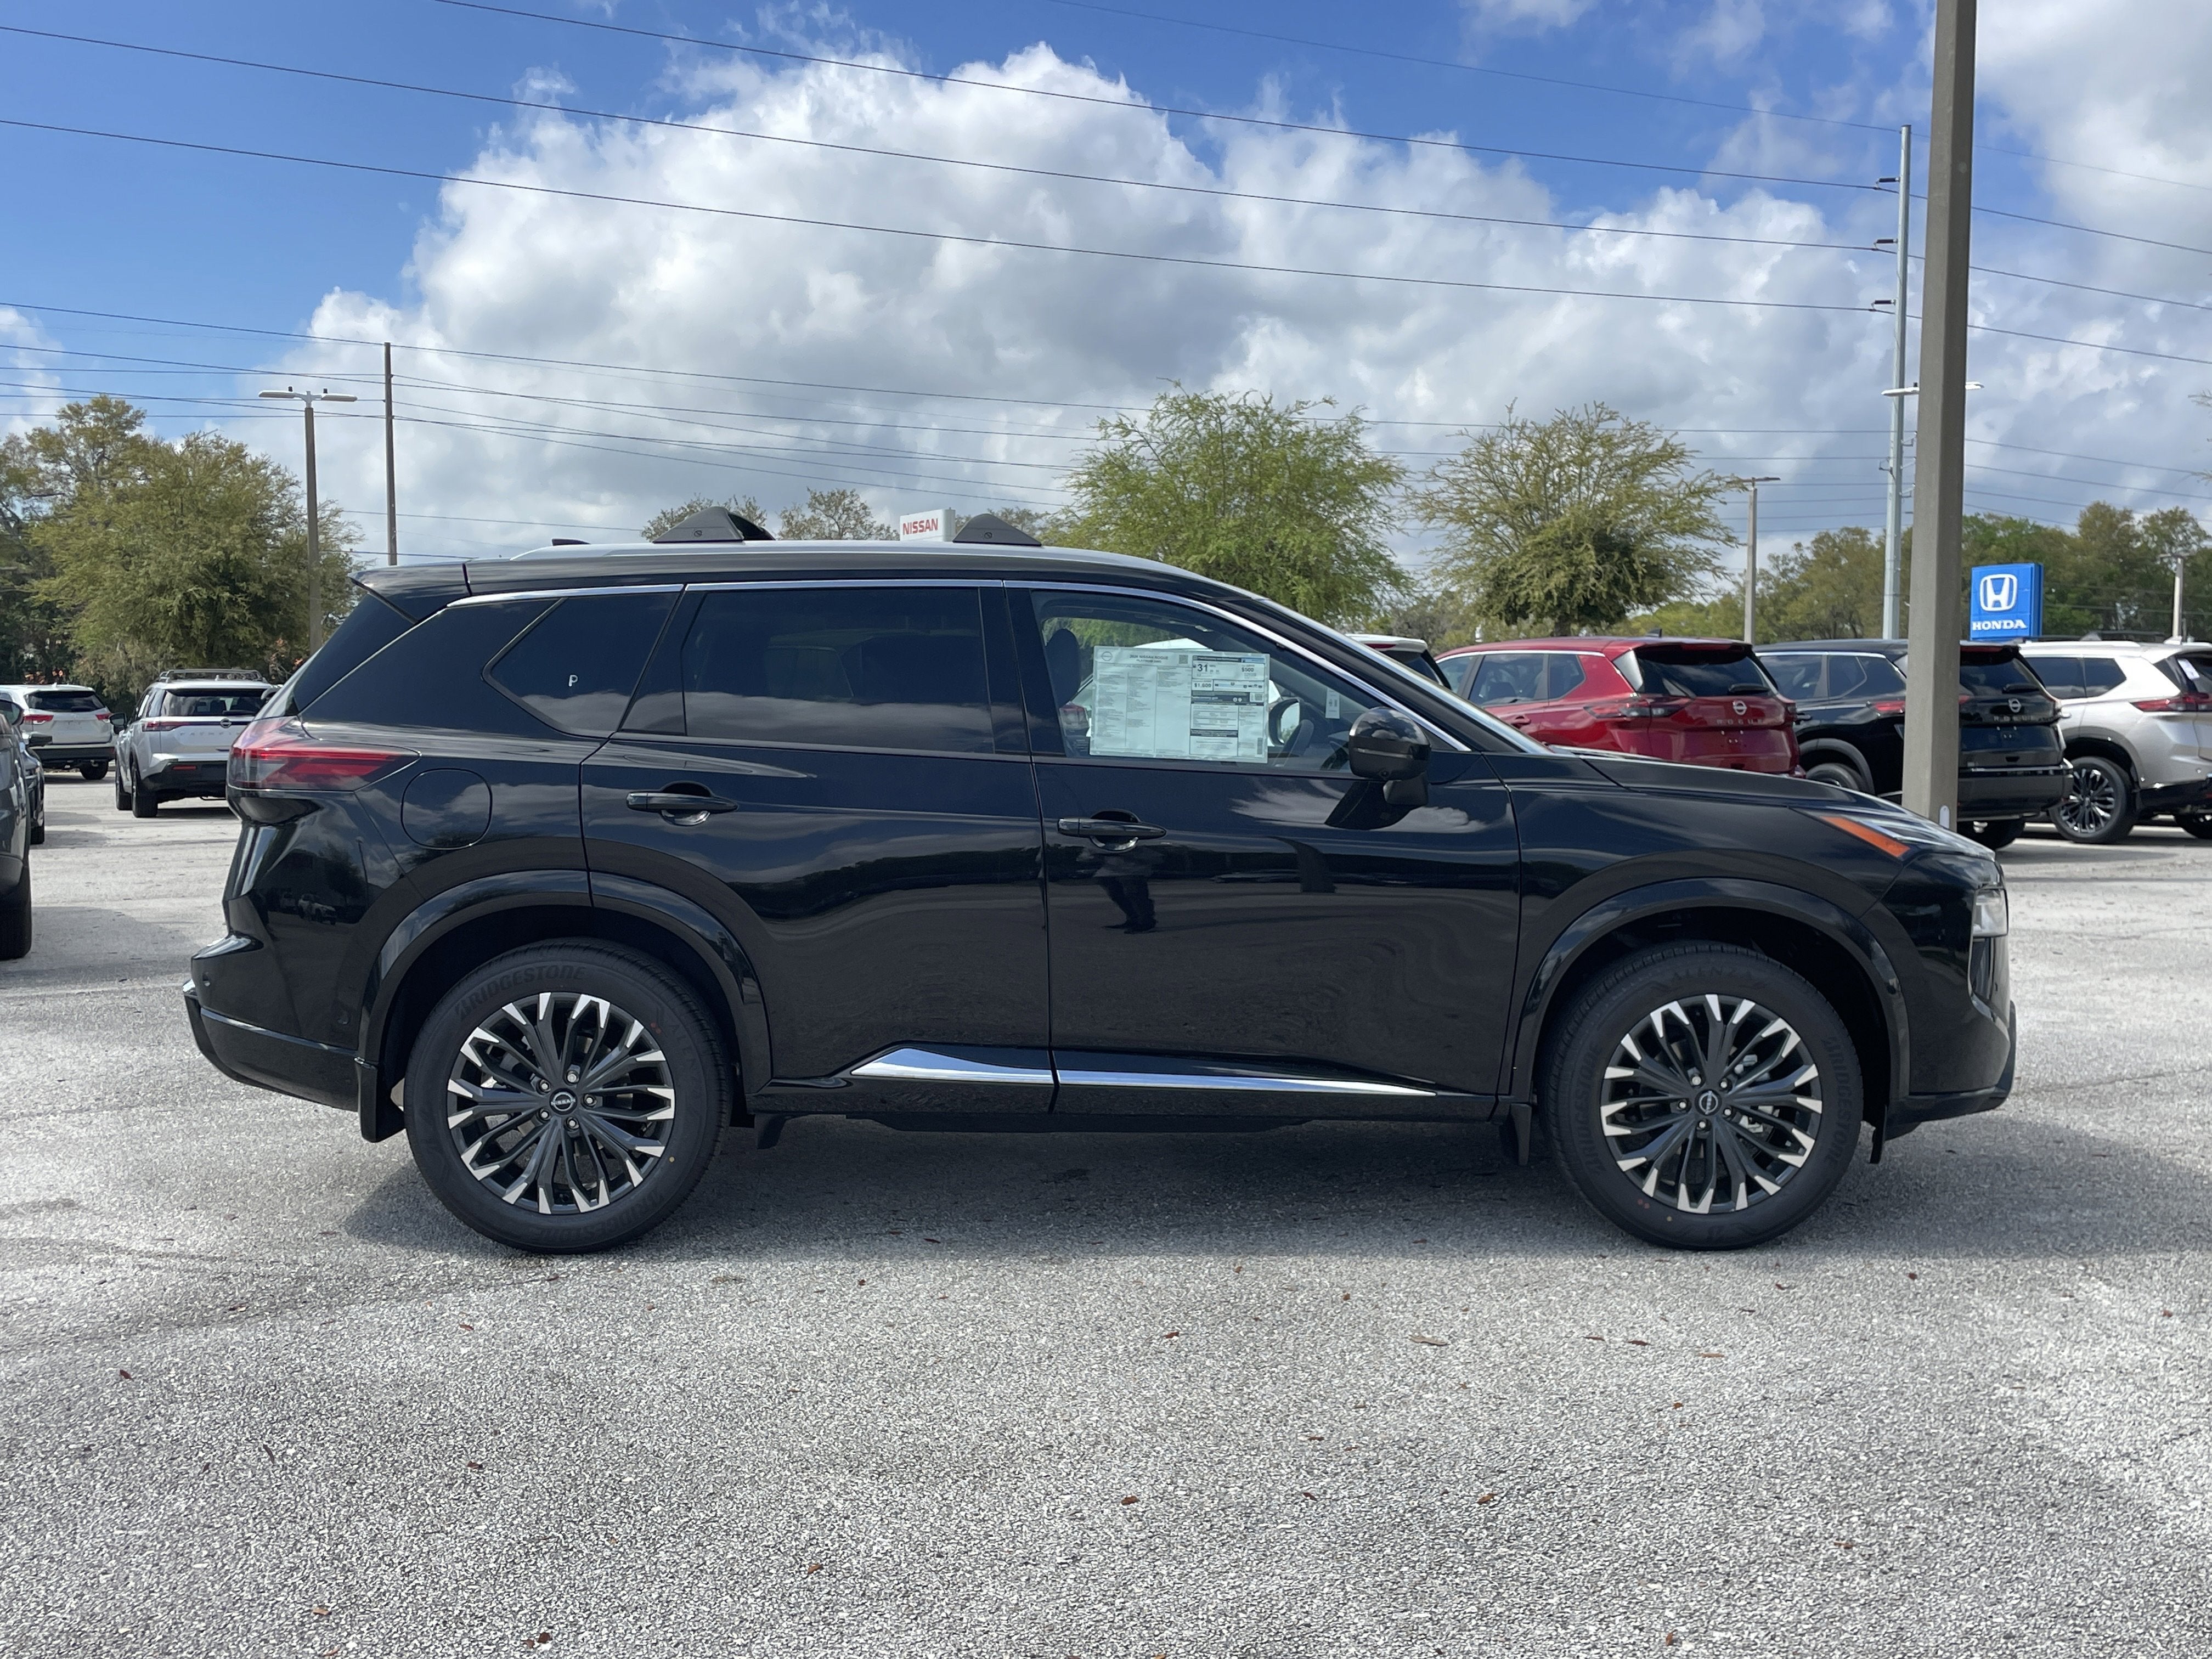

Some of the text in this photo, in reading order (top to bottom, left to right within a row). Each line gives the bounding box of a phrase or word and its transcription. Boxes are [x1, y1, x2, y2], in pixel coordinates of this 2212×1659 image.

[902, 518, 939, 535] NISSAN
[1972, 619, 2028, 631] HONDA
[1197, 663, 1208, 672] 31
[568, 674, 578, 687] P
[455, 964, 587, 1020] BRIDGESTONE
